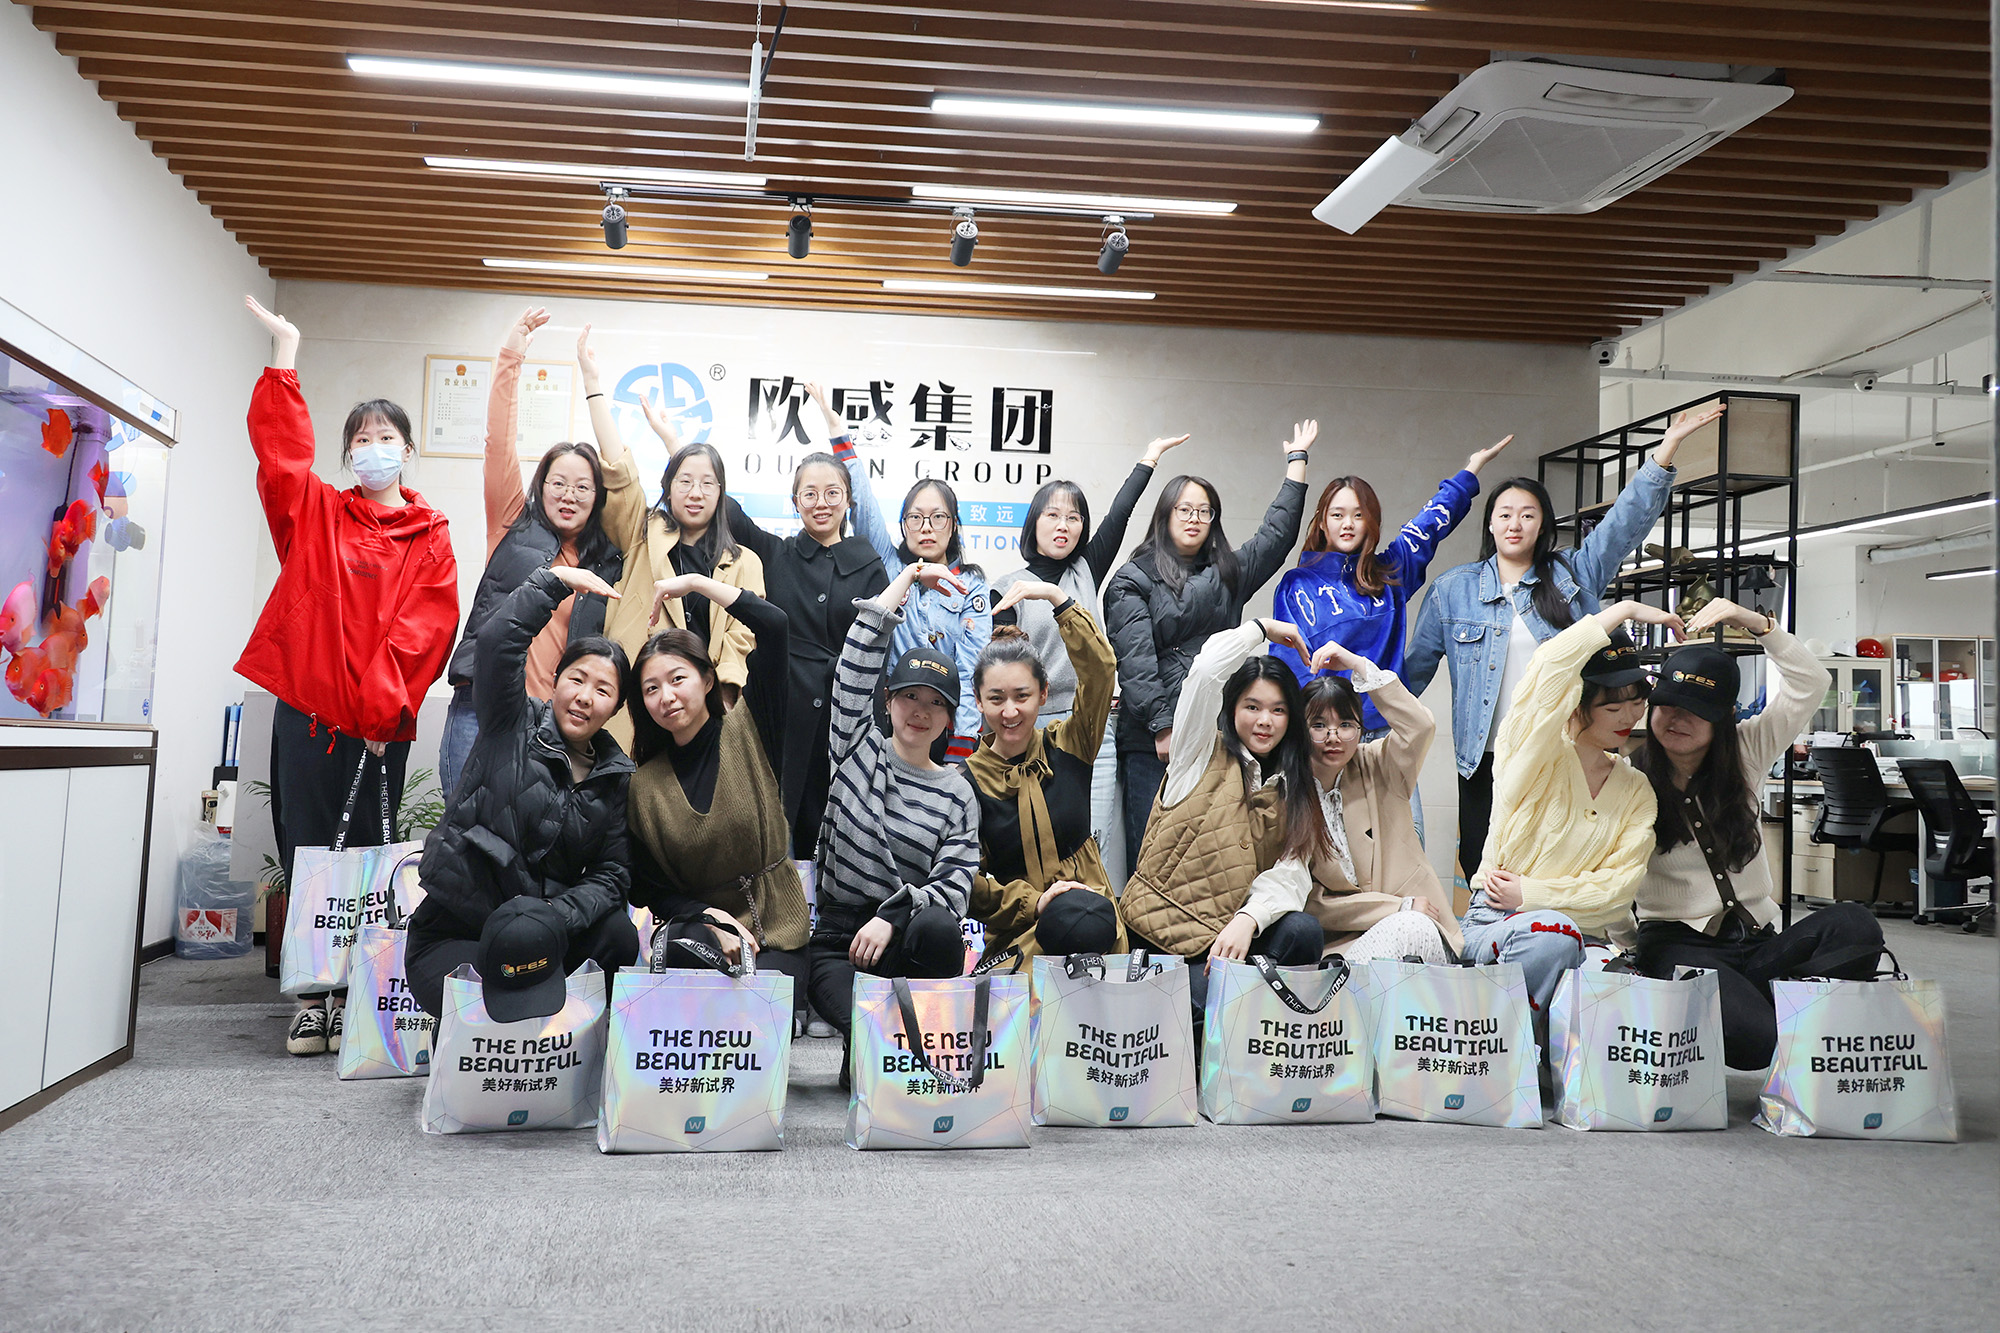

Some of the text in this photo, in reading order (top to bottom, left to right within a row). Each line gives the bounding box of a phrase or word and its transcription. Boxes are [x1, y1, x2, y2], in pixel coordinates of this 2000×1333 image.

[745, 452, 1052, 485] OUN GROUP
[958, 503, 1014, 523] 致远
[958, 534, 1021, 550] TION
[1685, 673, 1717, 687] FES
[326, 897, 356, 912] THE
[516, 958, 548, 972] FES
[394, 1016, 438, 1031] 美好新
[1260, 1019, 1343, 1039] THE NEW
[1405, 1015, 1498, 1036] THE NEW
[472, 1031, 572, 1054] THE NEW
[649, 1029, 752, 1048] THE NEW
[893, 1032, 935, 1050] TE
[1078, 1023, 1160, 1049] THE NEW
[1394, 1034, 1508, 1056] BEAUTIFUL
[1618, 1025, 1697, 1048] THE NEW
[1821, 1034, 1915, 1052] THE NEW
[1065, 1041, 1169, 1068] BEAUTIFUL
[1247, 1038, 1353, 1059] BEAUTIFUL
[1607, 1045, 1705, 1067] BEAUTIFUL
[459, 1051, 582, 1073] BEAUTIFUL
[636, 1052, 761, 1071] BEAUTIFUL
[1269, 1062, 1335, 1079] 美好新试界
[1417, 1056, 1490, 1076] 美好新试界
[1811, 1054, 1928, 1073] BEAUTIFUL
[482, 1077, 557, 1092] 美好新试界
[659, 1077, 735, 1093] 美好新试界
[1086, 1067, 1149, 1088] 美好新试界
[1628, 1068, 1689, 1088] 美好新试界
[1837, 1077, 1905, 1094] 美好新试界
